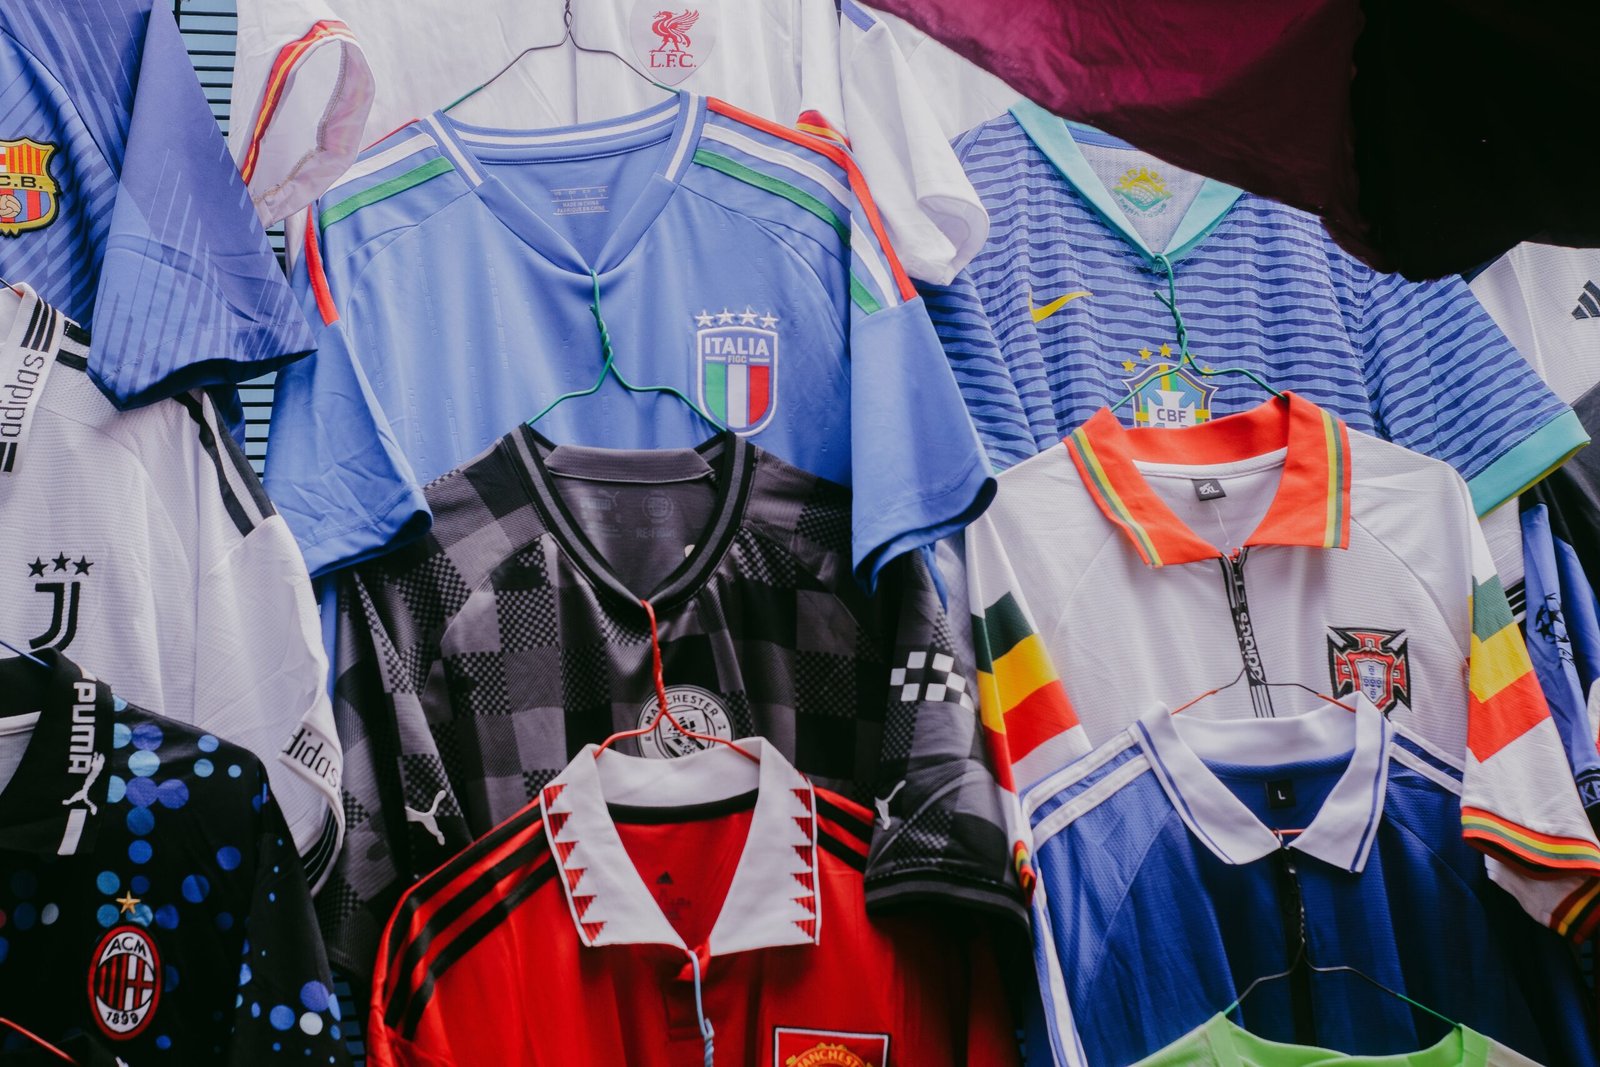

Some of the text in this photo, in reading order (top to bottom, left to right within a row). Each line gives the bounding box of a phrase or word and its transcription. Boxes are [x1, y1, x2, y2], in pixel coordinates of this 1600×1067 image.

[650, 53, 696, 68] L.F.C.
[705, 337, 770, 356] ITALIA
[727, 355, 748, 364] FIGC
[0, 353, 45, 437] adidas
[1156, 408, 1187, 422] CBF
[68, 682, 96, 774] PUMA
[1277, 790, 1286, 800] L
[107, 936, 147, 957] ACM
[106, 1012, 139, 1025] 1899
